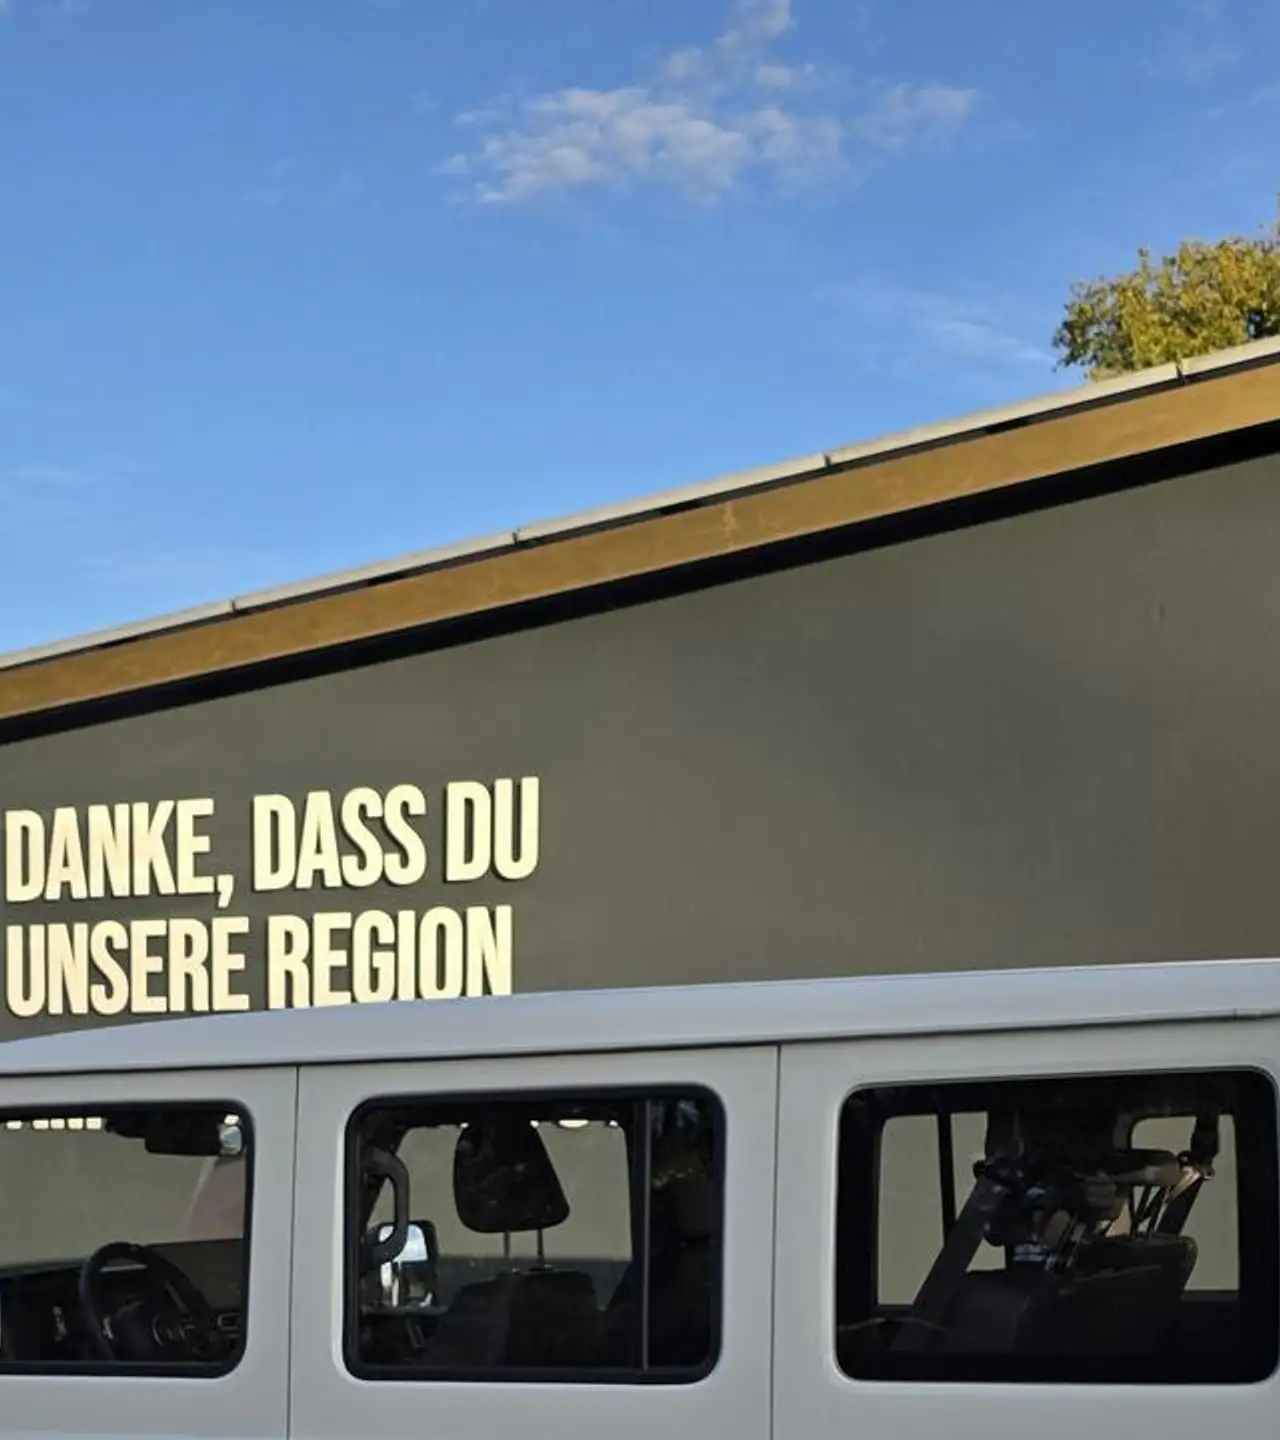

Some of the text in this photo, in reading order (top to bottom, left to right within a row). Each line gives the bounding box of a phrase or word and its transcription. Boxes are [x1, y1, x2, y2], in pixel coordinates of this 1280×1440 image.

[5, 775, 540, 907] DANKE, DASS DU
[6, 904, 513, 1016] UNSERE REGION
